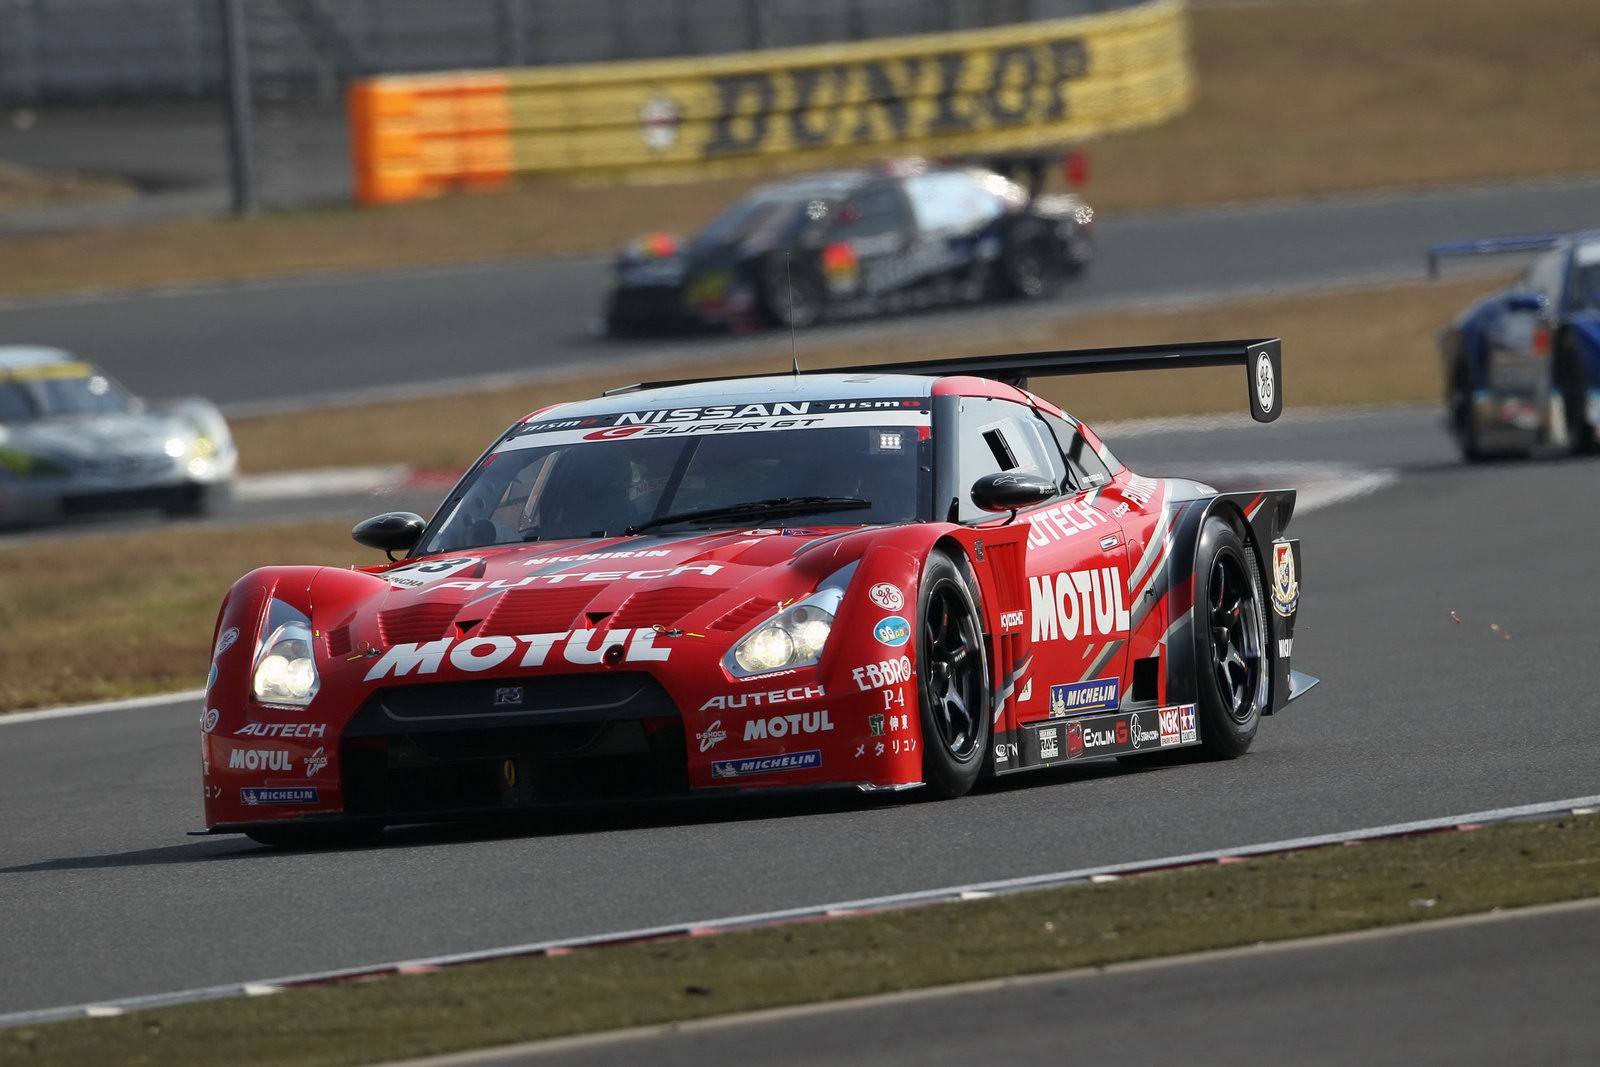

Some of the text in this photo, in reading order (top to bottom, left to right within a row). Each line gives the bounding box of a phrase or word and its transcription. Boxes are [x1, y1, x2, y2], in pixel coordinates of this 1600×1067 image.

[704, 38, 1092, 156] DUNLOP
[522, 400, 920, 433] nismo NISSAN nismo
[642, 418, 824, 436] SUPER GT
[522, 549, 672, 567] NICHIRIN
[416, 564, 724, 596] AUTECH
[1029, 566, 1130, 643] MOTUL
[363, 627, 672, 682] MOTUL
[852, 656, 911, 692] EBBRO
[699, 684, 826, 711] AUTECH
[883, 687, 905, 711] P-4
[1066, 684, 1116, 707] MICHELIN
[233, 723, 327, 738] AUTECH
[743, 710, 834, 741] MOTUL
[1160, 711, 1180, 735] NGK
[854, 738, 917, 758] メタリコン
[1083, 728, 1116, 748] EXILIM
[229, 748, 293, 771] MOTUL
[740, 754, 816, 771] MICHELIN
[259, 791, 313, 800] MICHELIN
